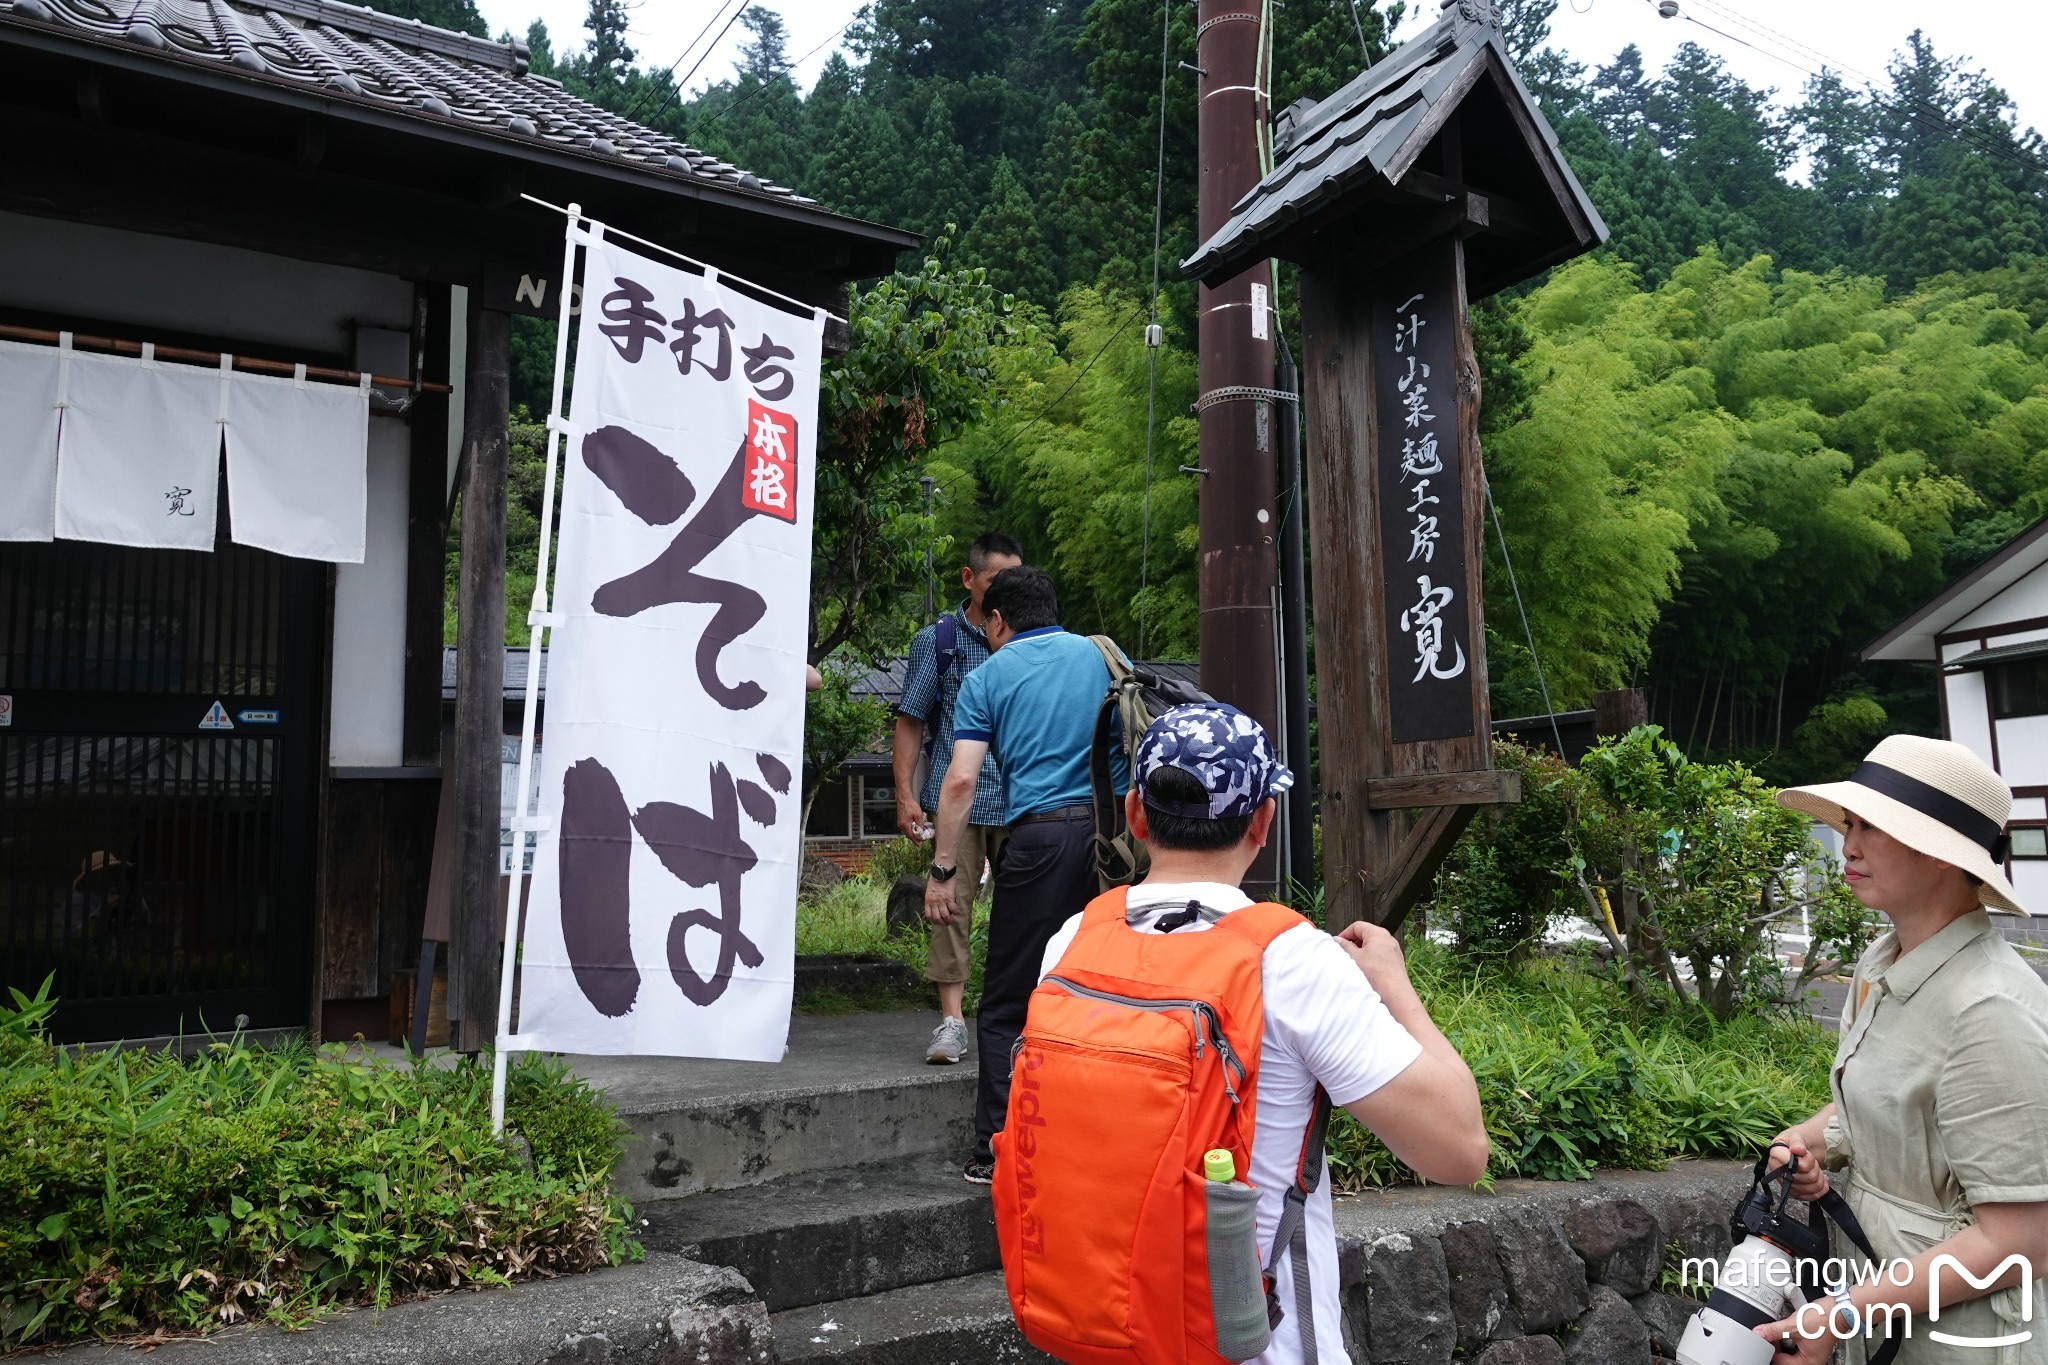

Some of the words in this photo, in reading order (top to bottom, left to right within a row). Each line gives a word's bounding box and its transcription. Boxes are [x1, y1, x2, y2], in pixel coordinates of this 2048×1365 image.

[598, 276, 795, 401] 手打ち
[749, 412, 788, 509] 本格
[560, 424, 792, 1018] そば
